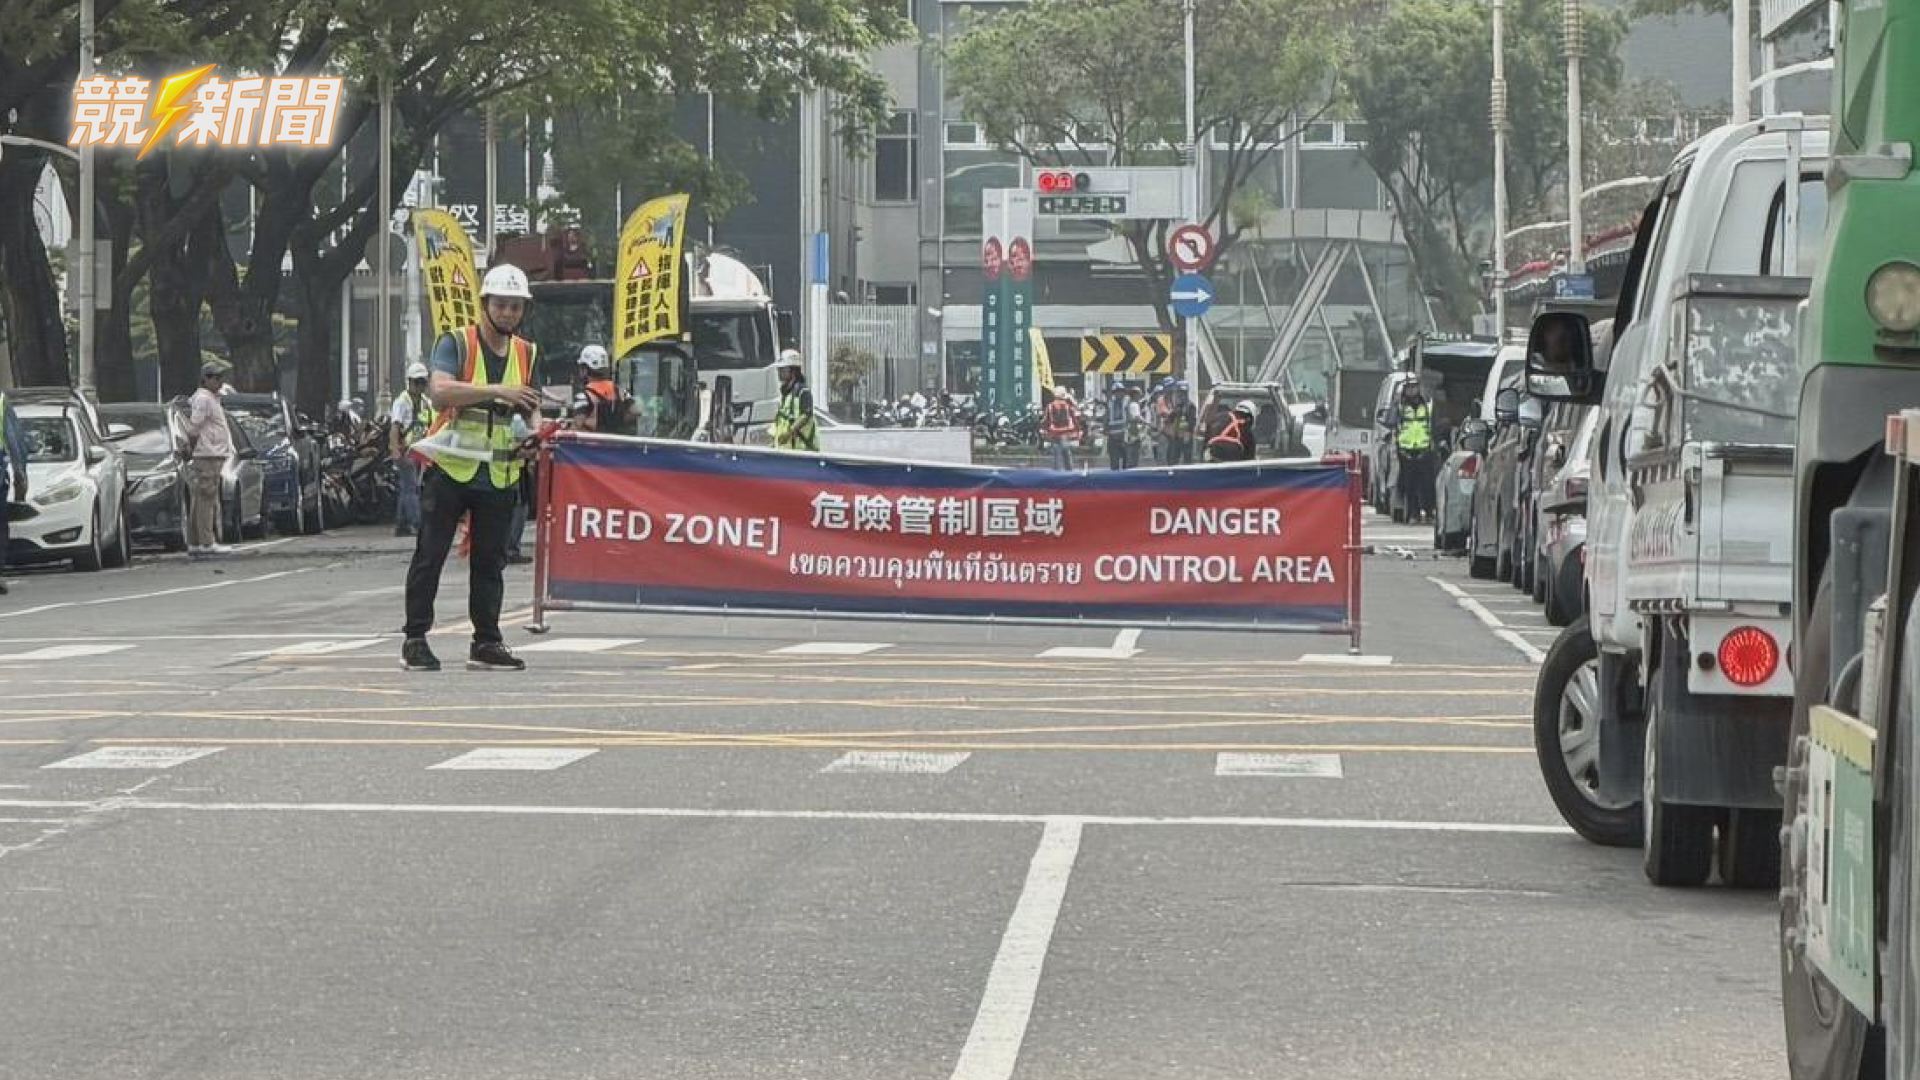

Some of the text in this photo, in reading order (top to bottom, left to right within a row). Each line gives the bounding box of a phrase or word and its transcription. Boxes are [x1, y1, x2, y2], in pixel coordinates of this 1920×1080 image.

[810, 491, 1064, 537] 危險管制區域
[1149, 507, 1281, 535] DANGER
[1094, 555, 1335, 583] CONTROL AREA
